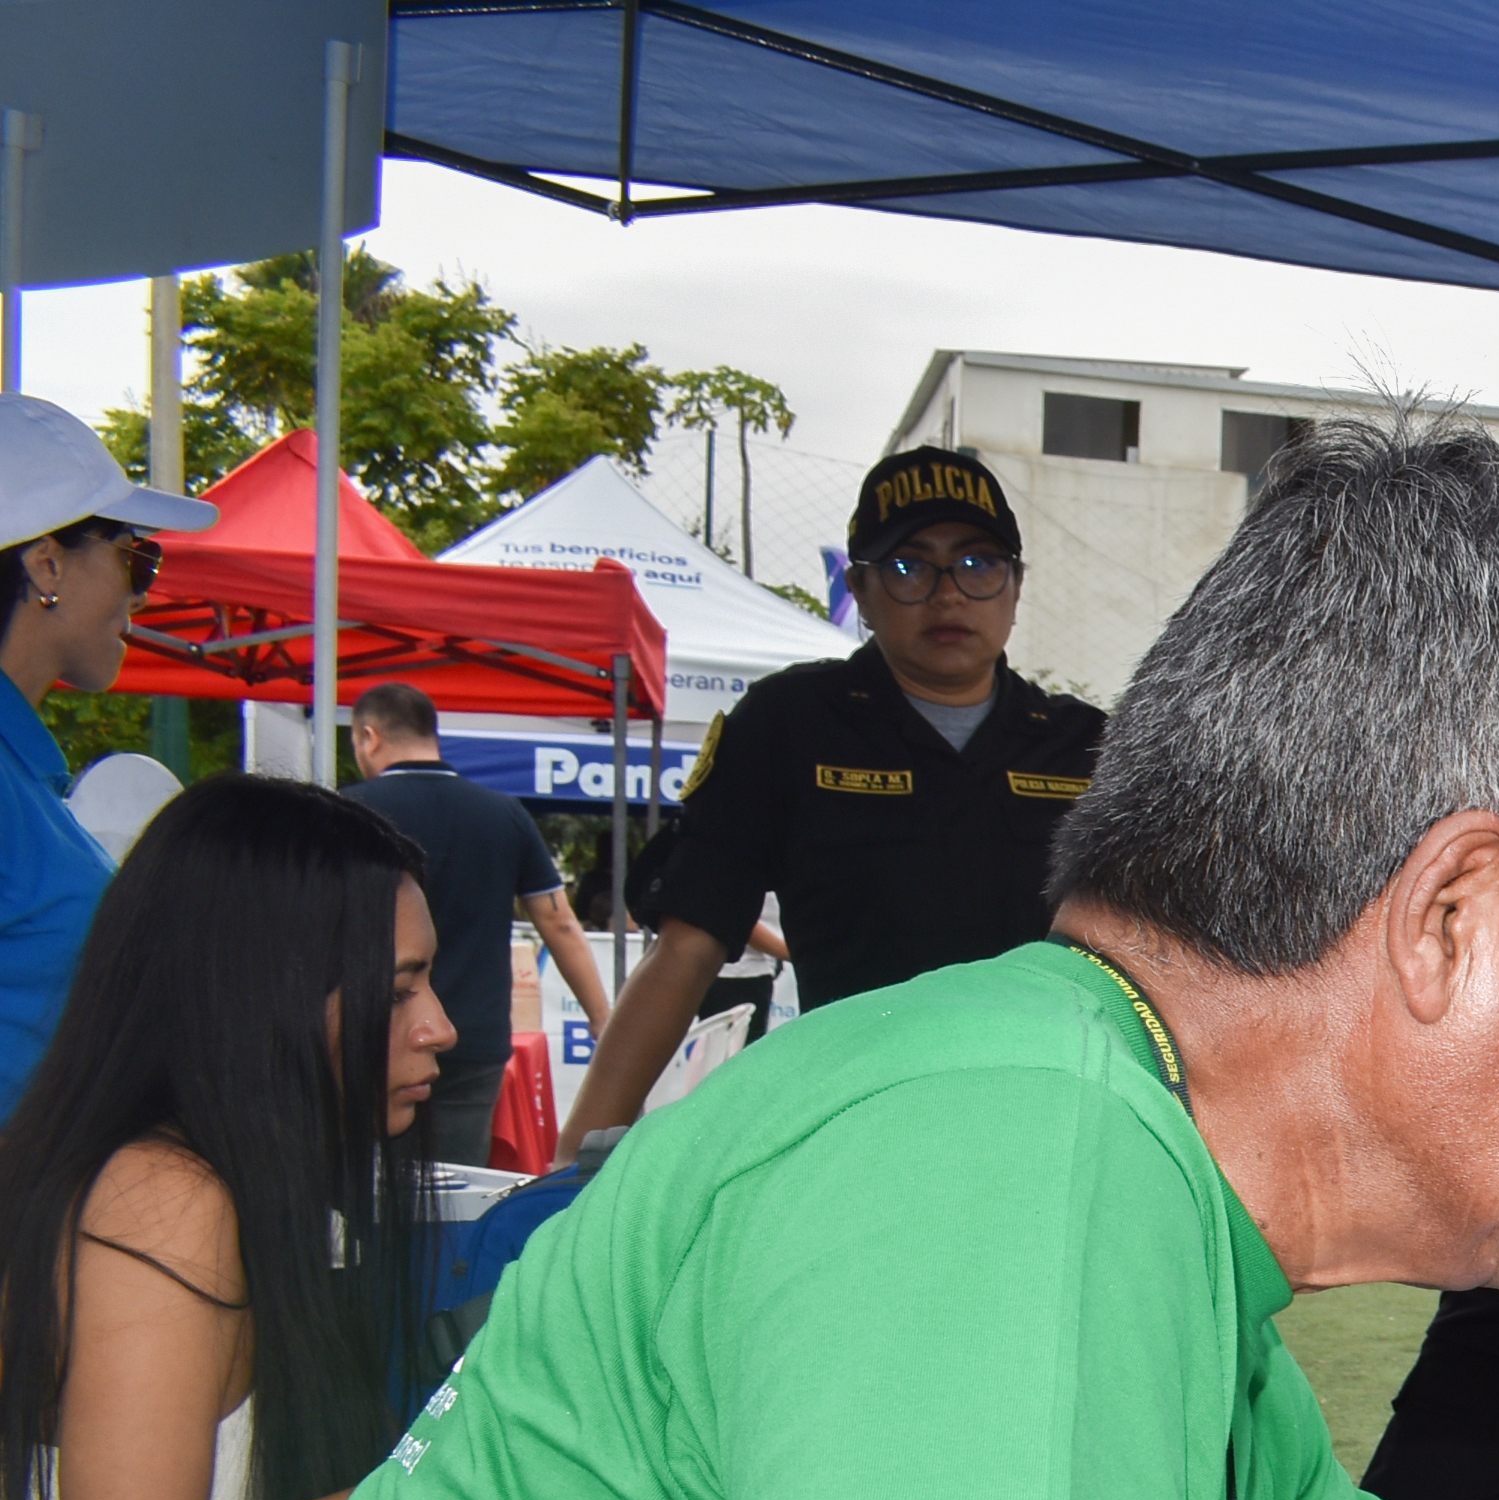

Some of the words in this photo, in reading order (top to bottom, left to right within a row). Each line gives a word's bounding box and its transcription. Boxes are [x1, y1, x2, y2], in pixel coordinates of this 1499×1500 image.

[876, 464, 997, 522] POLICIA
[503, 543, 543, 554] Tus
[550, 542, 688, 567] beneficios
[643, 570, 702, 585] aquí
[665, 673, 725, 692] eran
[1134, 1001, 1180, 1083] SEGURIDAD
